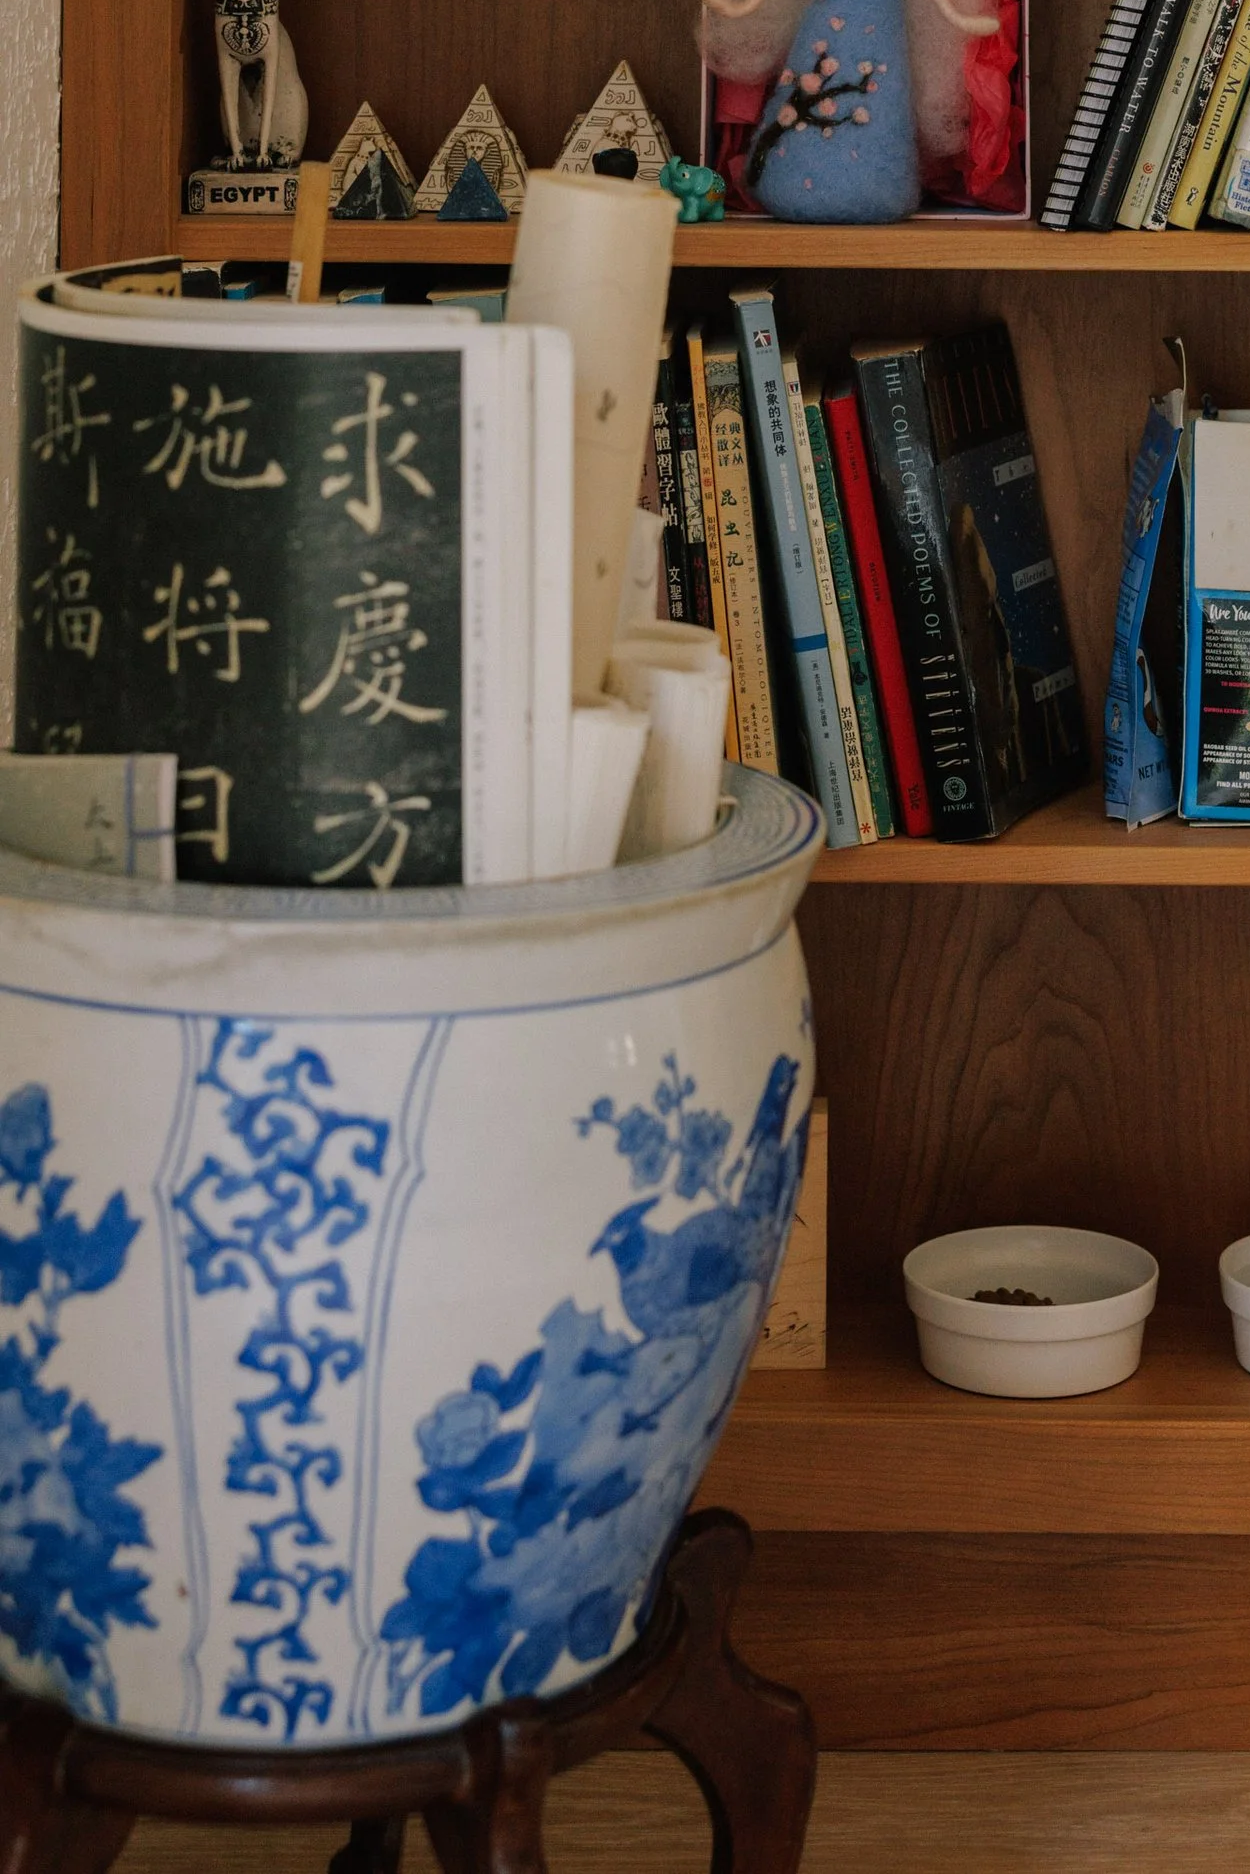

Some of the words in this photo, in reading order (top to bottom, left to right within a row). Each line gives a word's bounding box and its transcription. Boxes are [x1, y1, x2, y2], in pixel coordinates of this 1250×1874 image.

[1143, 47, 1159, 68] TO
[1232, 52, 1247, 71] the
[1120, 77, 1149, 133] WATER
[1203, 75, 1241, 151] Mountain
[210, 186, 280, 203] EGYPT
[884, 358, 904, 398] THE
[764, 380, 787, 457] 想象的共同体
[891, 404, 922, 525] COLLECTED
[721, 488, 744, 567] 昆虫记
[910, 532, 936, 605] POEMS
[924, 612, 942, 640] OF
[1209, 604, 1231, 620] Are
[840, 705, 863, 782] 宫泽贤治童话
[906, 782, 920, 811] Yale
[1216, 780, 1231, 788] FIND
[1231, 781, 1242, 789] ALL
[942, 801, 975, 813] VINTAGE
